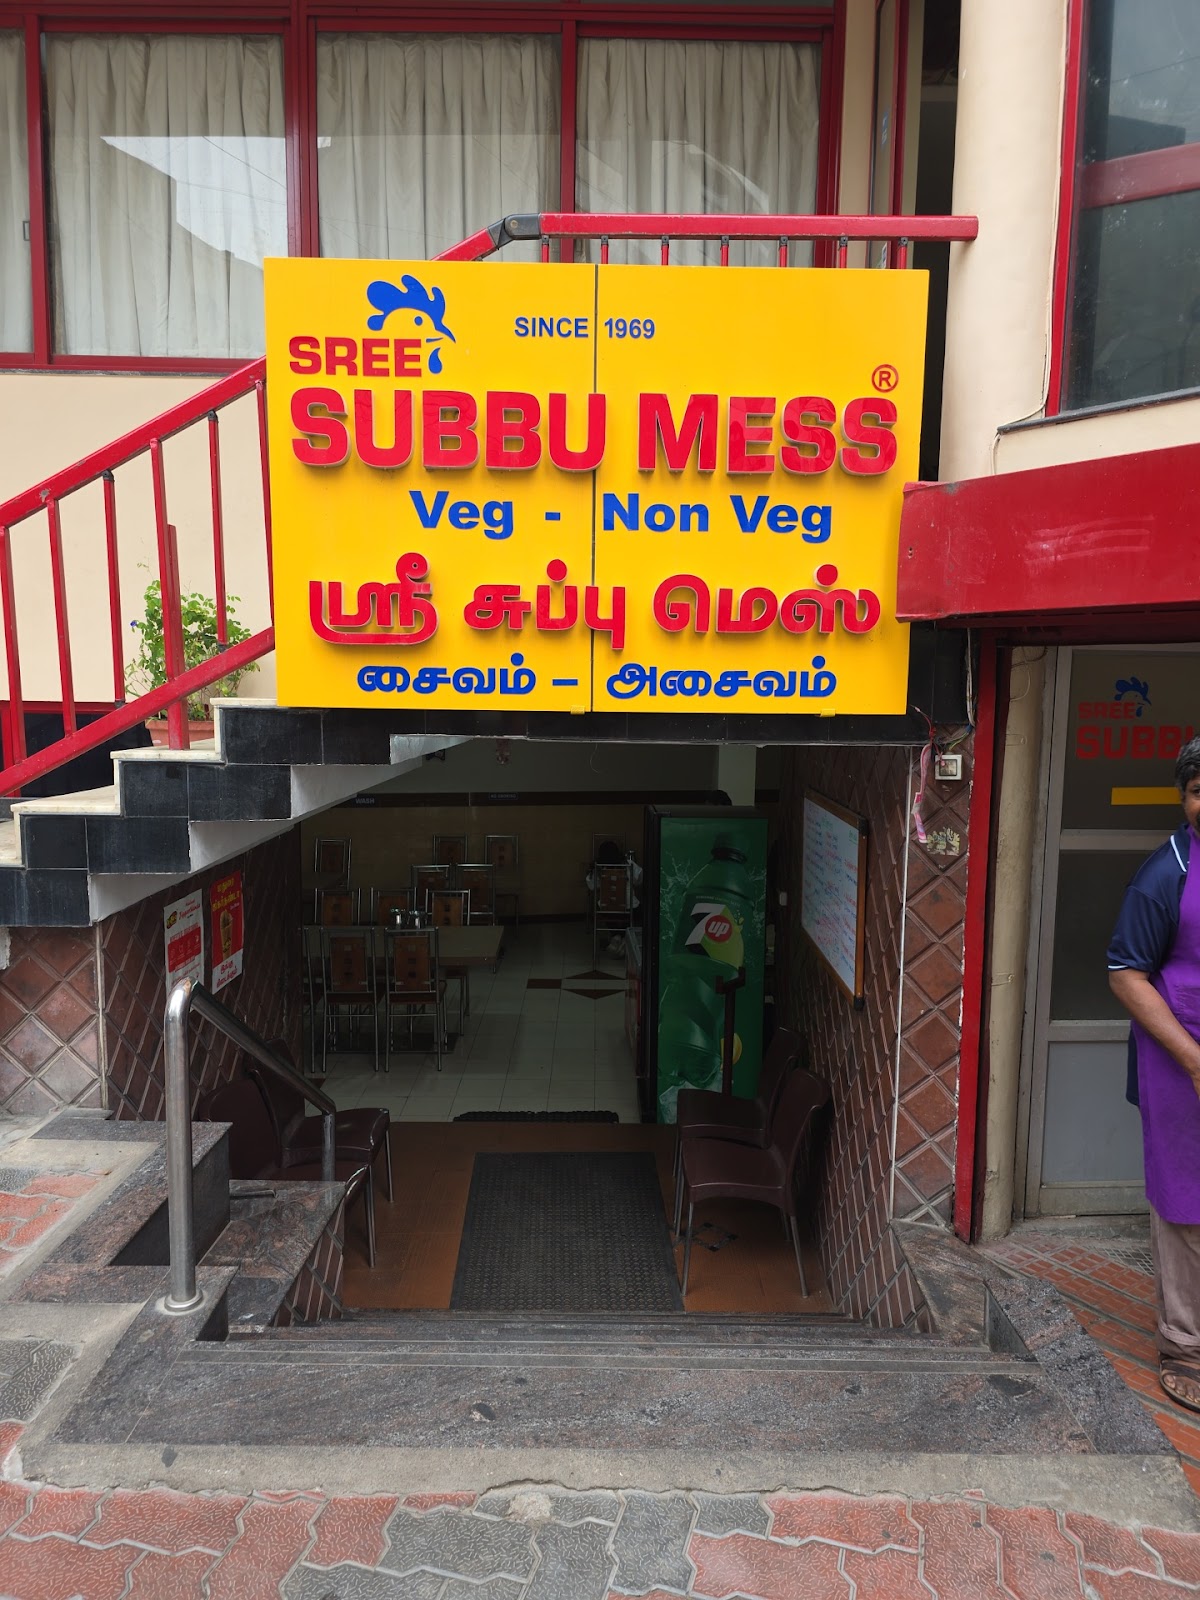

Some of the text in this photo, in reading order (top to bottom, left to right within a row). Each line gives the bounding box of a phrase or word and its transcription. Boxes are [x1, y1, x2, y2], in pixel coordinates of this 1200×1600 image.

[515, 317, 655, 339] SINCE 1969
[289, 335, 421, 377] SREE
[290, 387, 898, 476] SUBBU MESS
[409, 490, 514, 540] Veg
[603, 493, 709, 532] Non
[730, 495, 832, 543] Veg
[464, 559, 626, 650] சுப்பு
[653, 564, 881, 635] மெஸ்
[357, 653, 536, 695] சைவம்
[606, 655, 837, 699] அசைவம்
[1078, 702, 1136, 720] SREE
